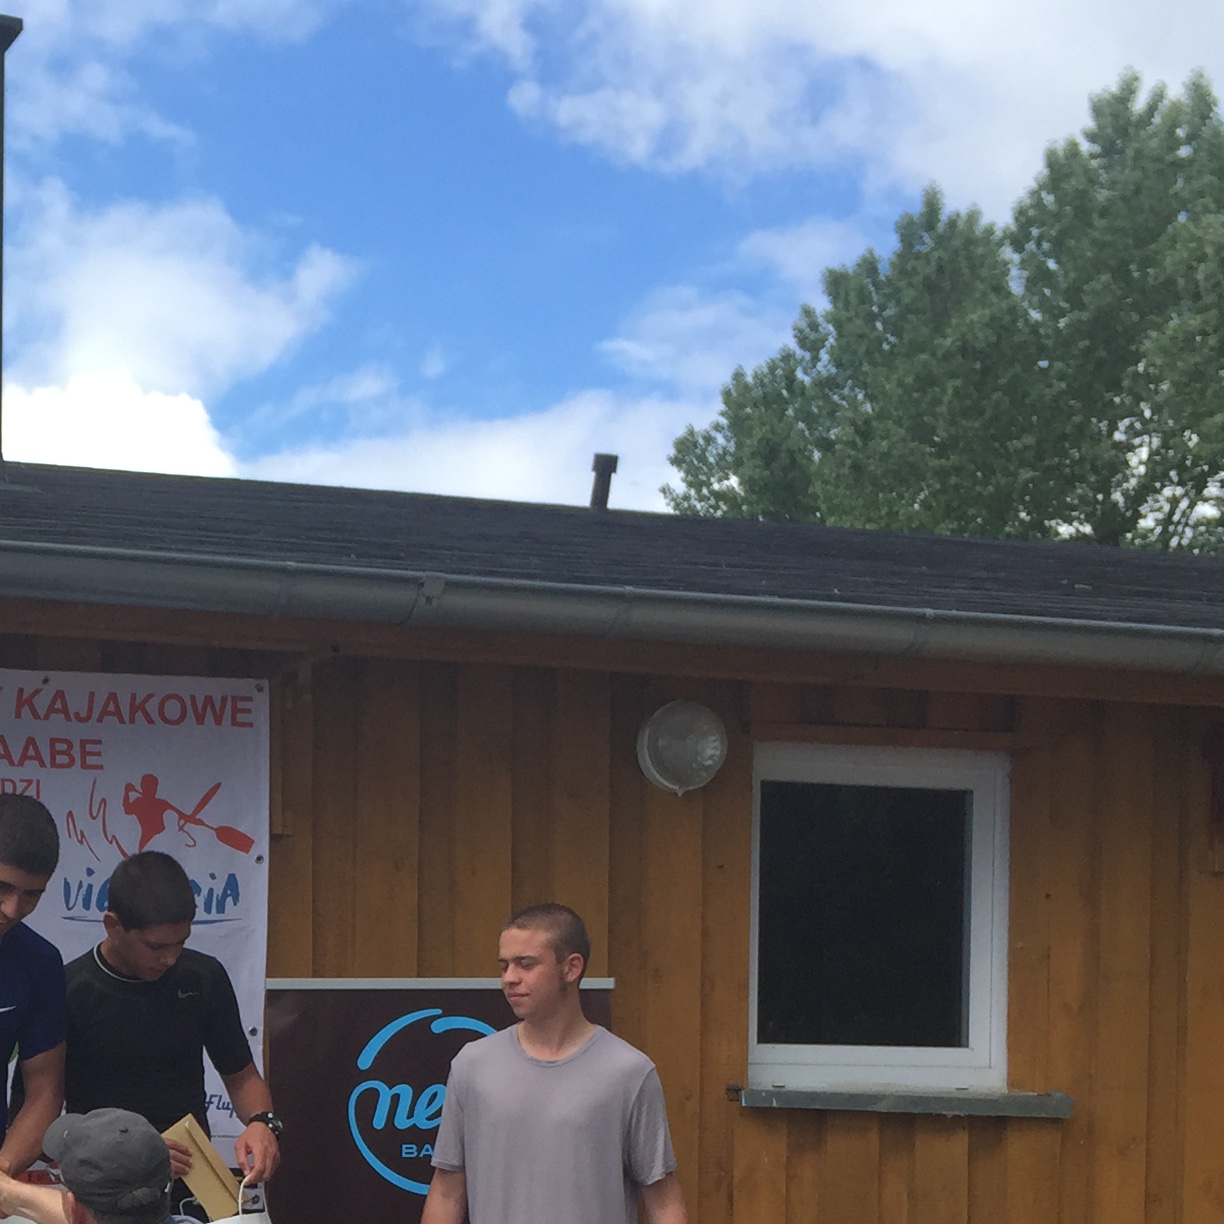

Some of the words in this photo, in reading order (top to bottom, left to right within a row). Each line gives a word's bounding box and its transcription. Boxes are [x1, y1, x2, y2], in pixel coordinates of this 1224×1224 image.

[14, 687, 254, 728] KAJAKOWE
[348, 1080, 447, 1130] ne
[401, 1144, 435, 1158] BA
